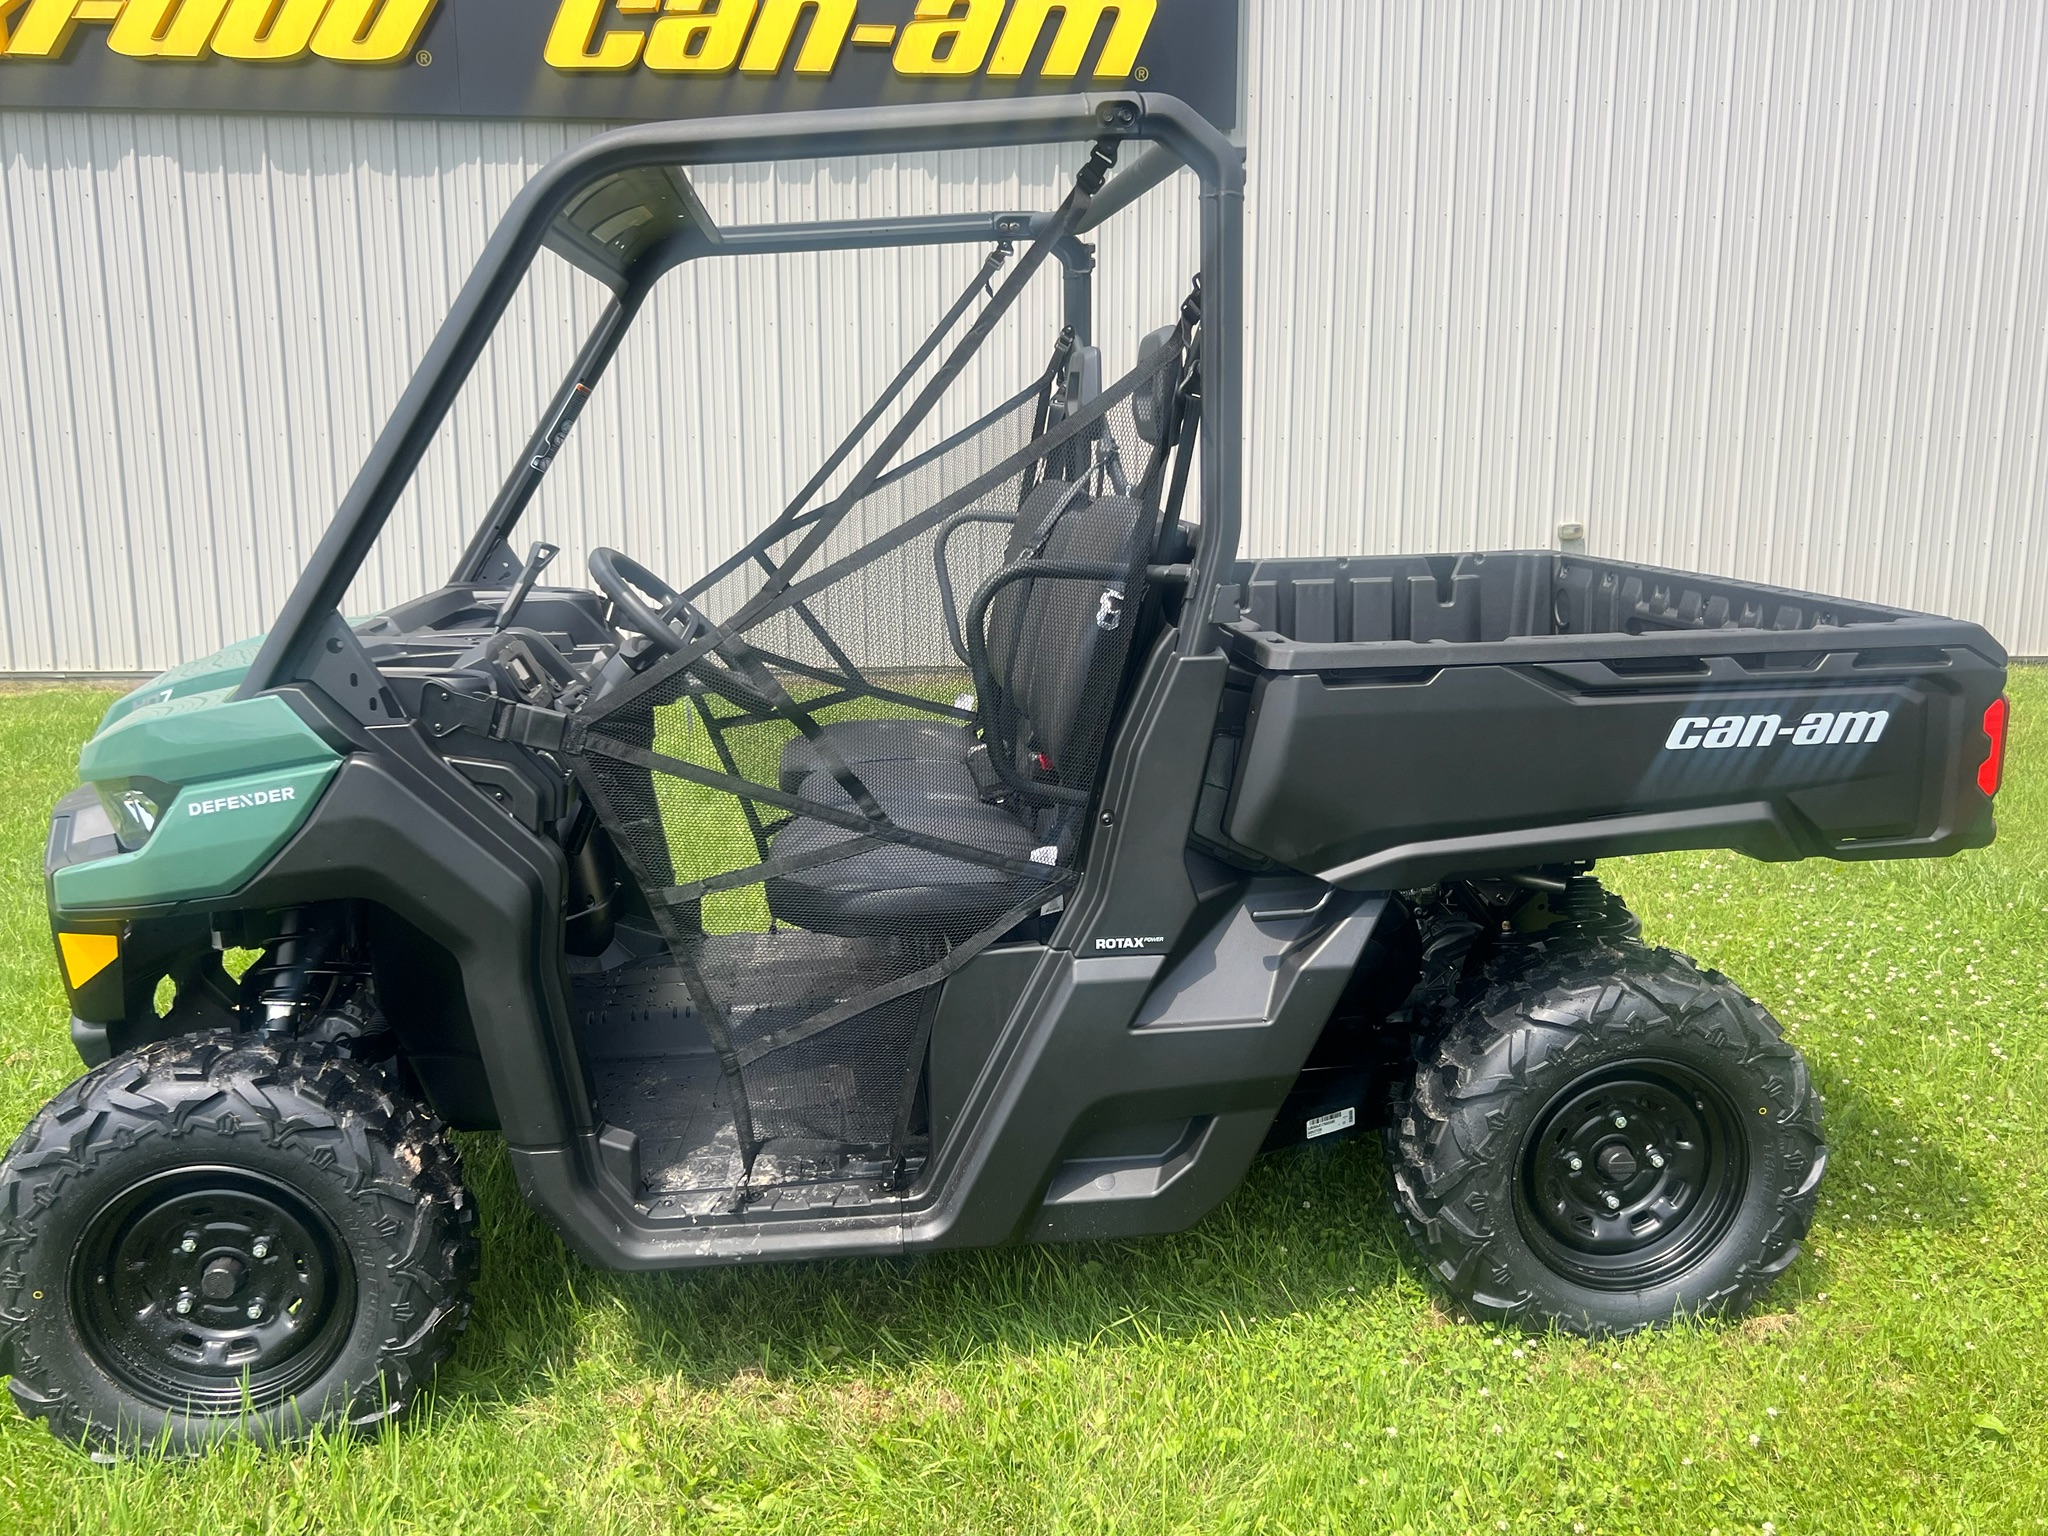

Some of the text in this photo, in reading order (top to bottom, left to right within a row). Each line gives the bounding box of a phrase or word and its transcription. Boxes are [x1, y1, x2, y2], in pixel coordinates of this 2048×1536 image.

[1665, 710, 1889, 750] can-am
[188, 787, 295, 816] DEFENDER
[1095, 937, 1144, 949] ROTAX
